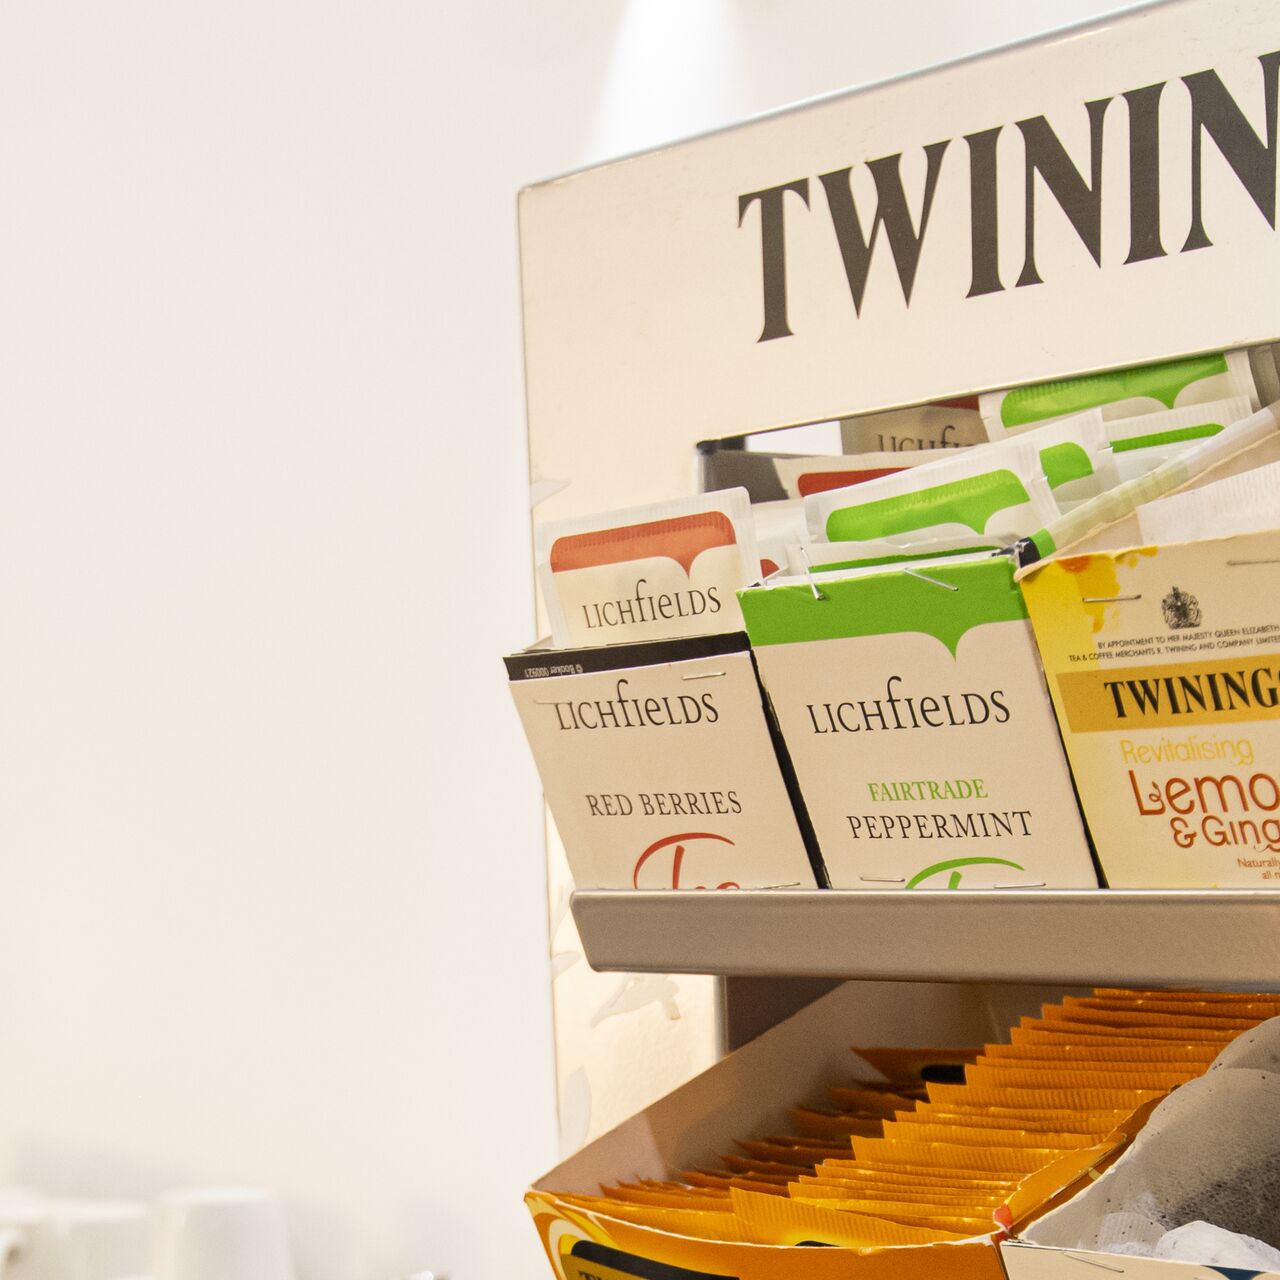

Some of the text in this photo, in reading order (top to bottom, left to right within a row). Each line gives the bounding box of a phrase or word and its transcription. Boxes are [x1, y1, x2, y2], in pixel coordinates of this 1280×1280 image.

[1097, 624, 1280, 649] BY APPOINTMENT TO HER MAJESTY QUEEN ELIZABETH
[1069, 654, 1081, 662] TEA
[1088, 650, 1114, 660] COFFEE
[1115, 647, 1156, 658] MERCHANTS
[1165, 644, 1197, 653] TWINING
[1199, 641, 1215, 650] AND
[1217, 639, 1253, 649] COMPANY
[1120, 735, 1255, 766] Revitalising
[867, 778, 989, 801] FAIRTRADE
[585, 790, 742, 817] RED BERRIES
[846, 810, 1032, 840] PEPPERMINT
[1170, 816, 1197, 849] &
[1262, 870, 1271, 879] all
